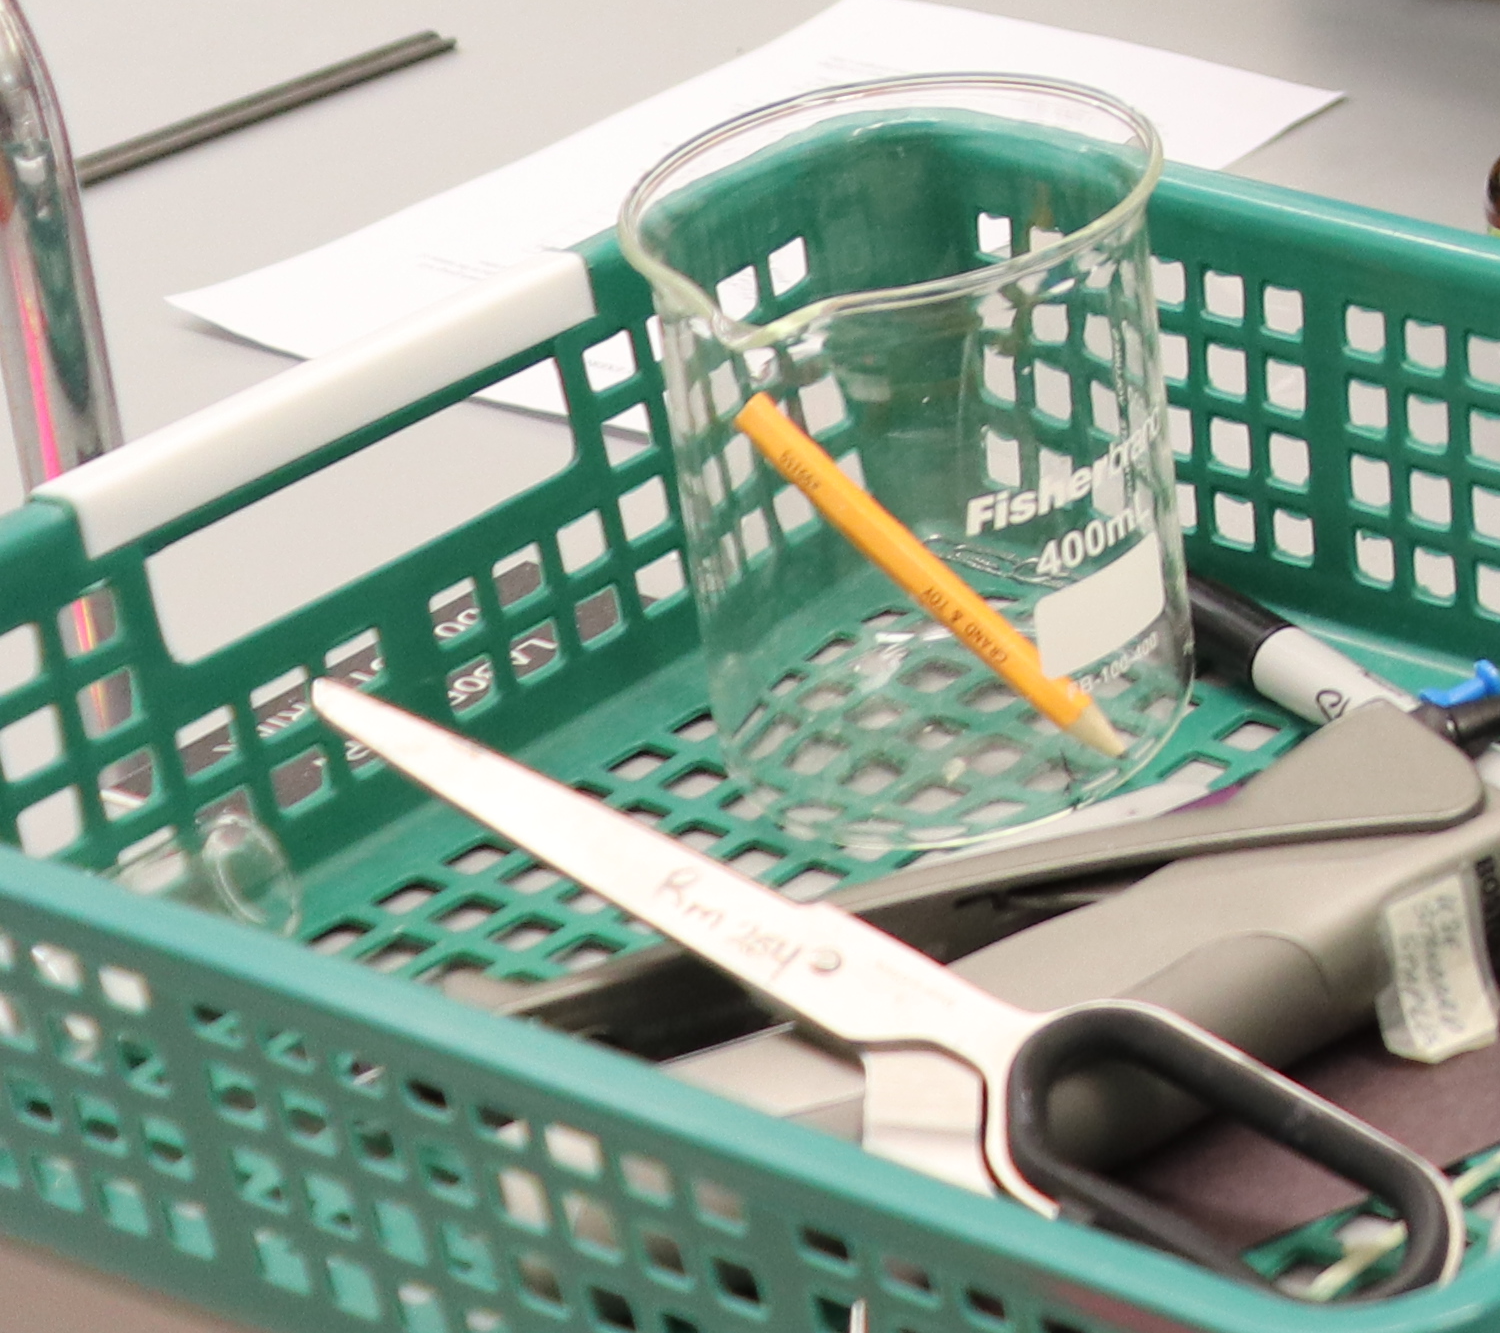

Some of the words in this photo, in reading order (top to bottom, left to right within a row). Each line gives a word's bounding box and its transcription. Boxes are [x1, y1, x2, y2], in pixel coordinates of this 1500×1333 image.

[1036, 489, 1150, 576] 400mL
[920, 586, 949, 614] TOY
[963, 622, 1008, 666] GRAND
